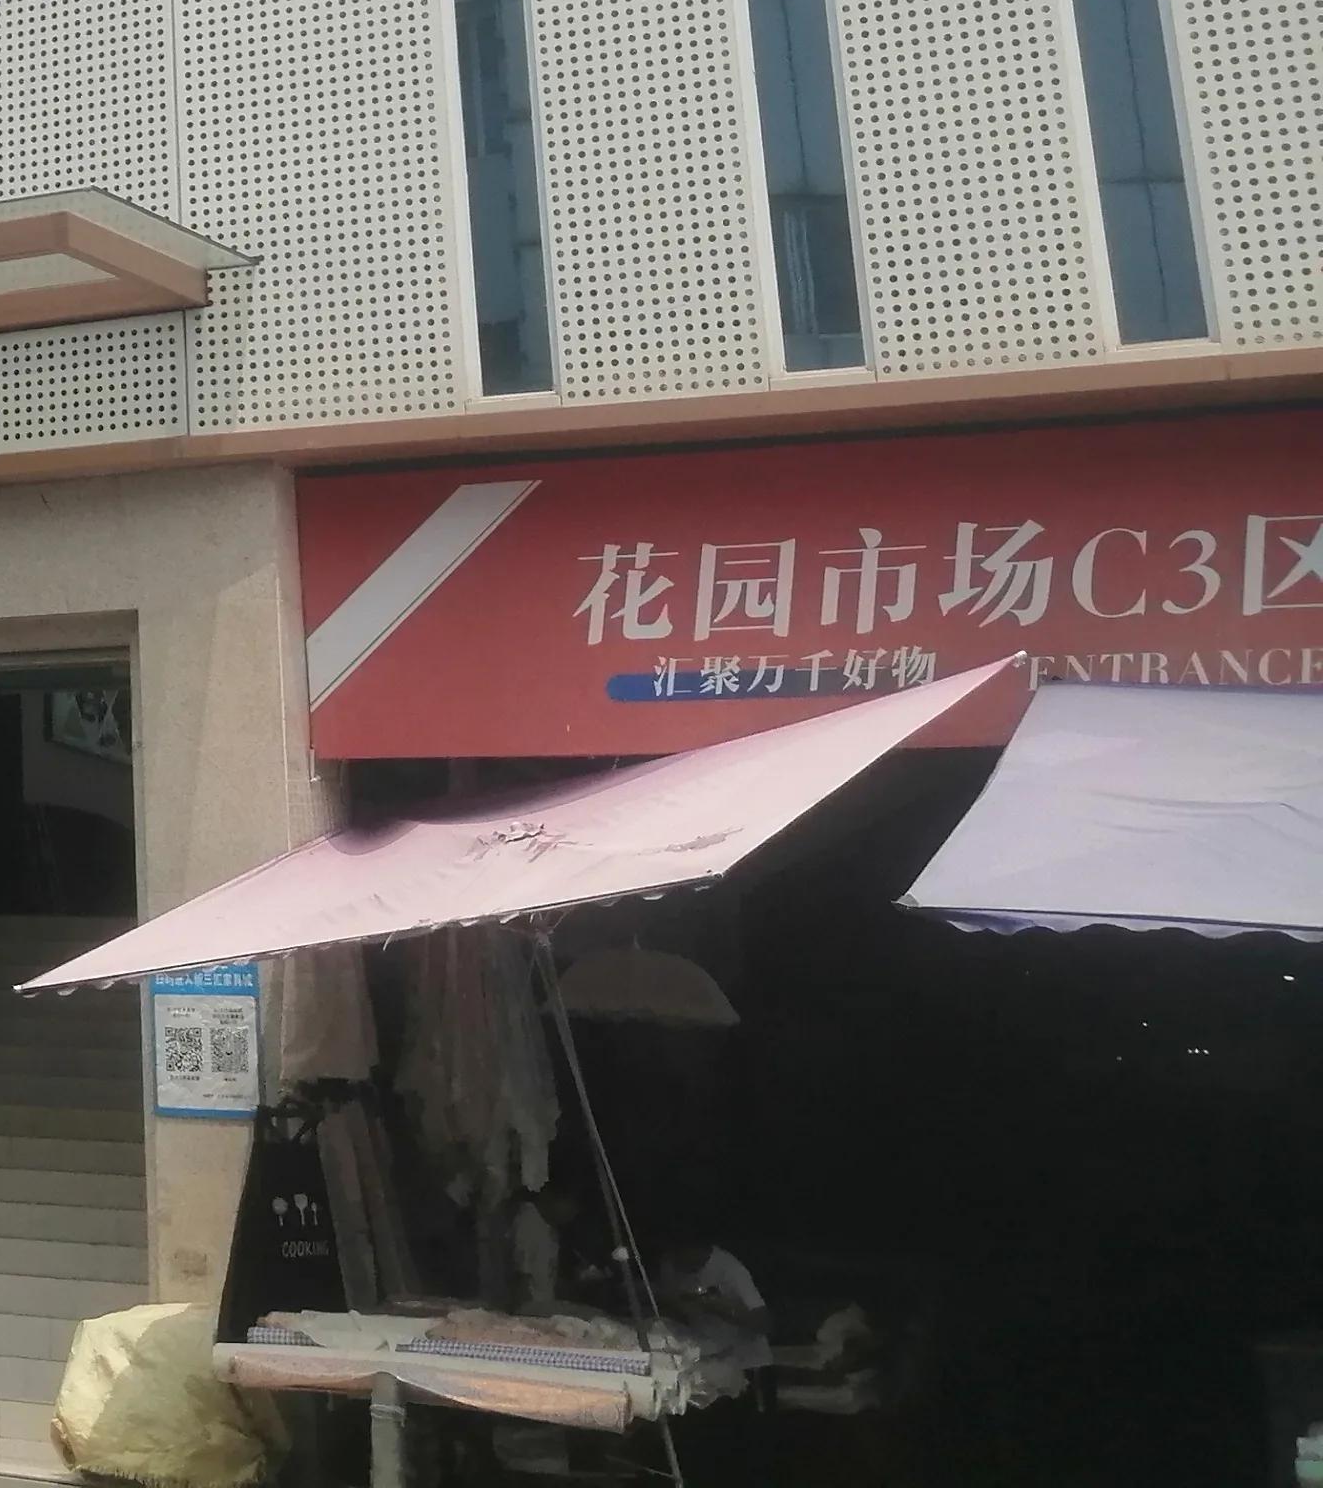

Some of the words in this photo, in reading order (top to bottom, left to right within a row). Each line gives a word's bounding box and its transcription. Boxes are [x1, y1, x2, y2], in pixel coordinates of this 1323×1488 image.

[573, 512, 1323, 647] 花园市场C3区
[653, 644, 938, 698] 汇聚万千好物
[281, 1240, 330, 1258] COOKING
